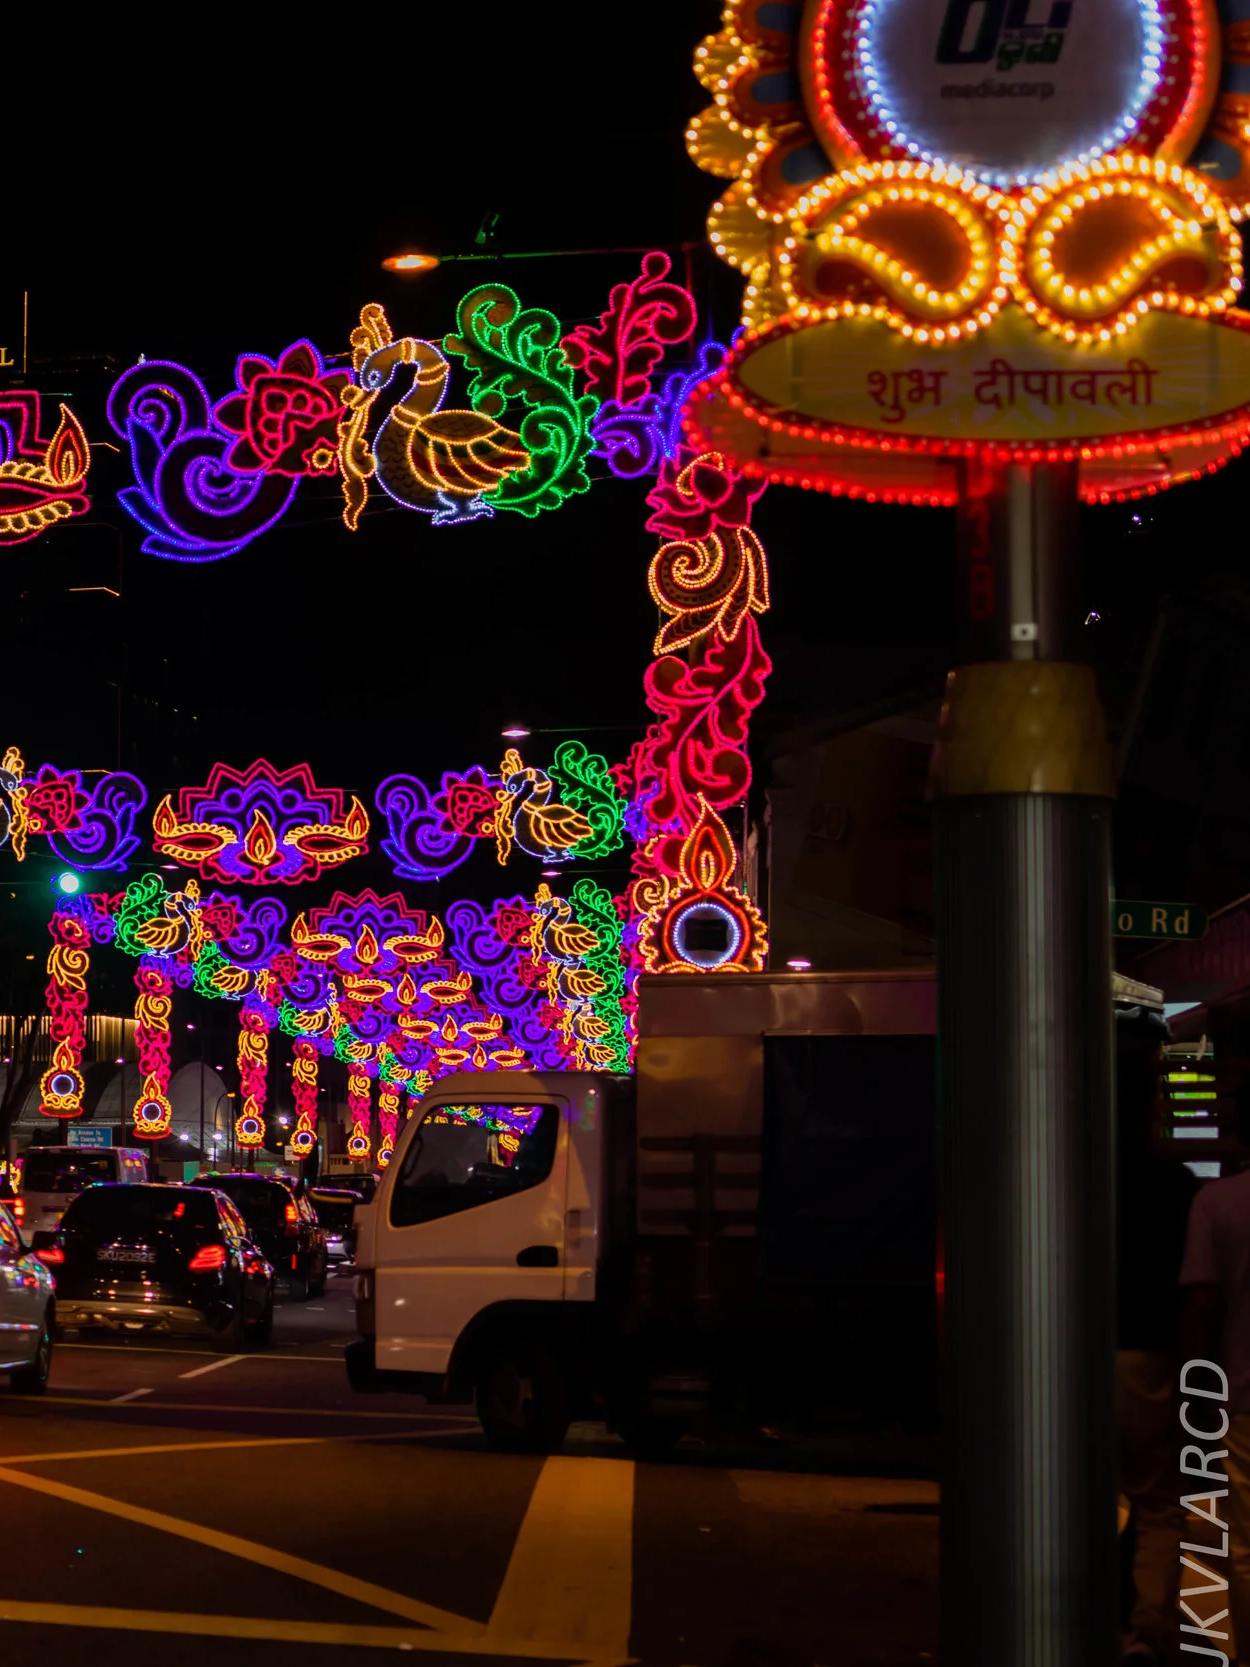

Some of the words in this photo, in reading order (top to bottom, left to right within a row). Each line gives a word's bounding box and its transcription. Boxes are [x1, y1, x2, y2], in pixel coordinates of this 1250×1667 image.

[940, 78, 1055, 101] mediacorp
[867, 368, 947, 423] शुभ
[974, 358, 1159, 409] दीपावली
[1151, 907, 1190, 934] Rd
